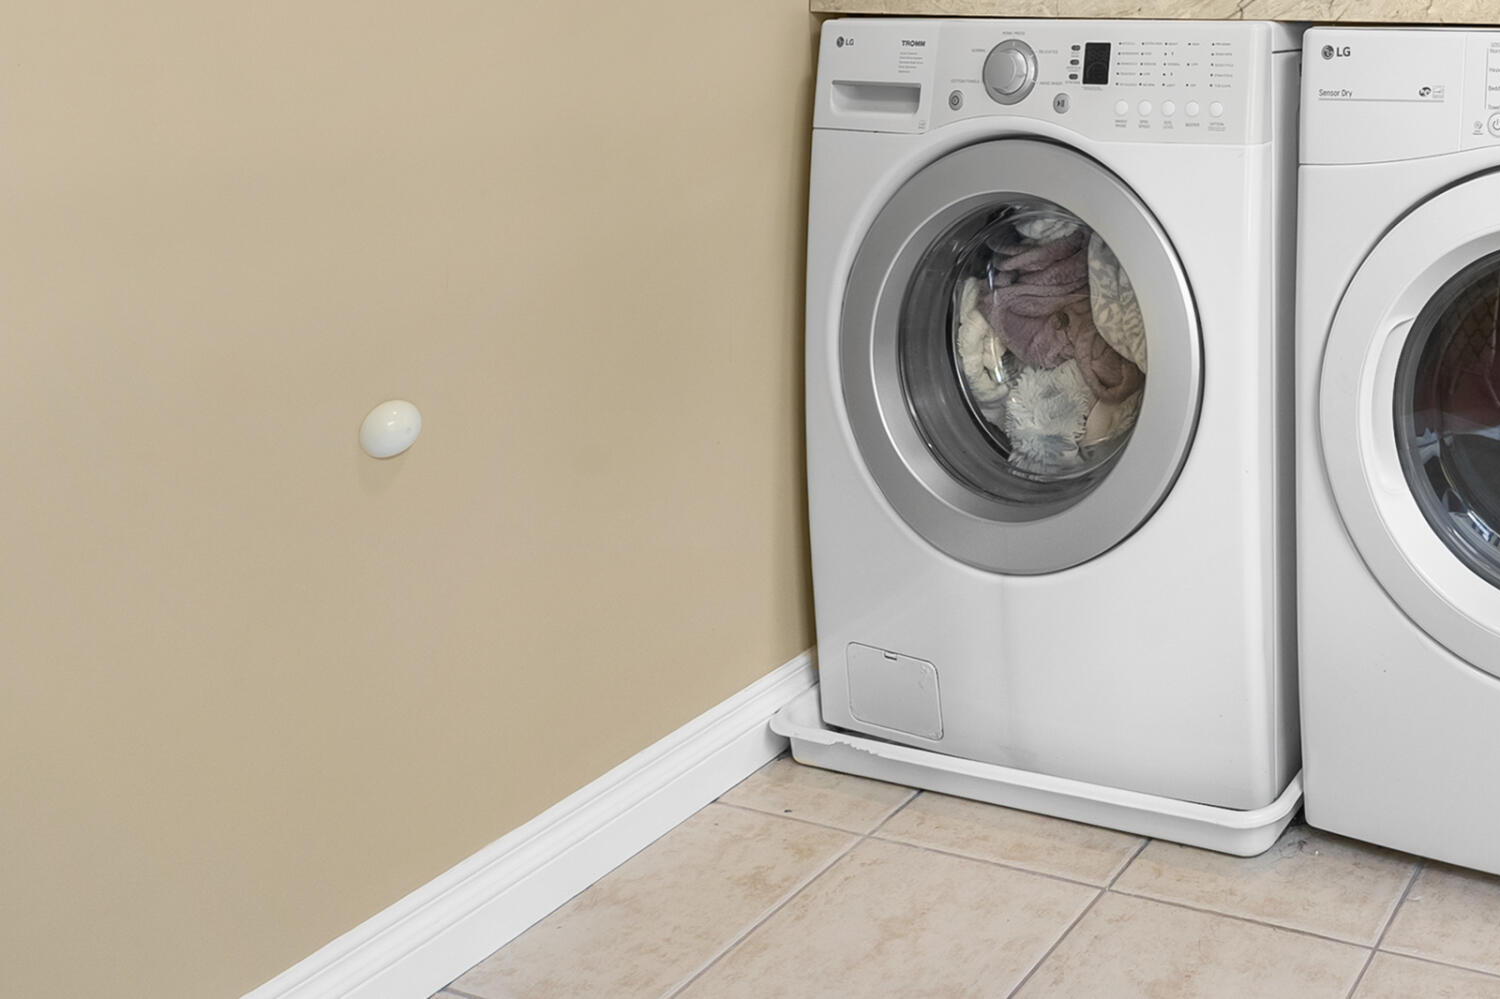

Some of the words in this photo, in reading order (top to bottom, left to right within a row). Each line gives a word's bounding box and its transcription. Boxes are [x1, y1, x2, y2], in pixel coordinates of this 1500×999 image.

[1336, 46, 1352, 58] LG
[1319, 88, 1340, 97] Sensor
[1340, 88, 1353, 99] Dry
